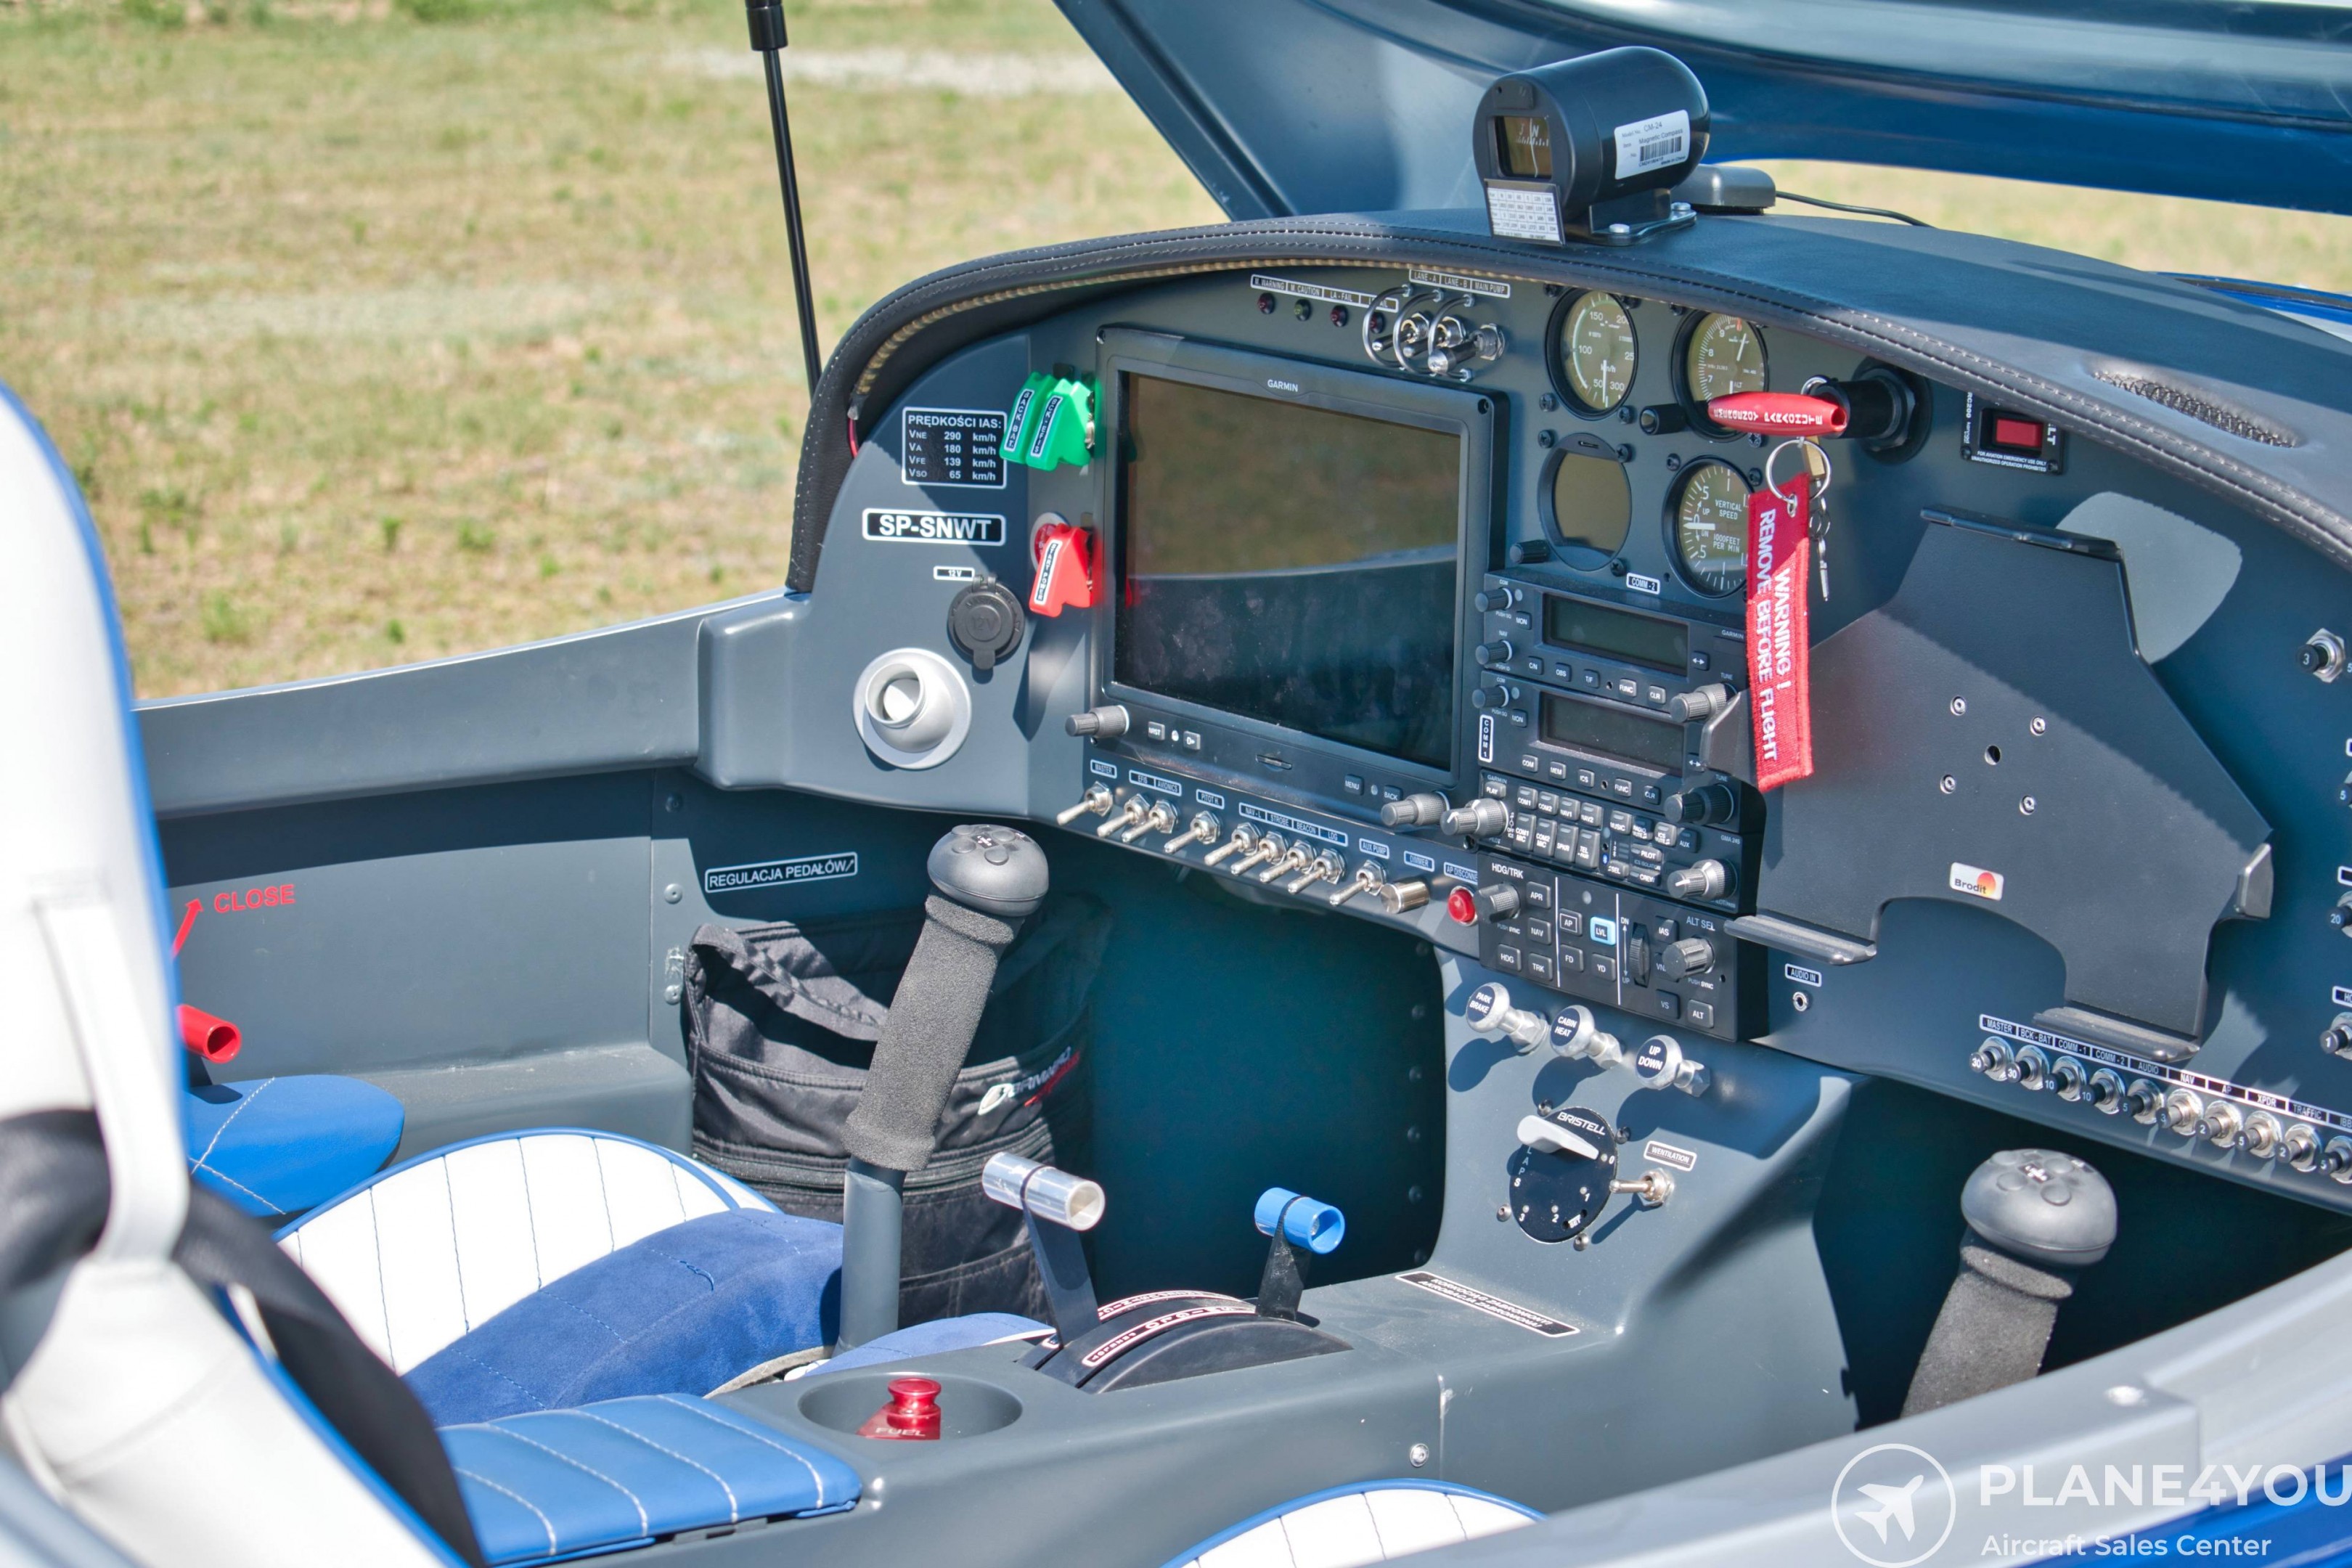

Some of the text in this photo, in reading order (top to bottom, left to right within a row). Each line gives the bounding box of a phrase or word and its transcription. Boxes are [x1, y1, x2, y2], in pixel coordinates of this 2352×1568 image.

[1643, 122, 1662, 132] CM-24
[1638, 128, 1683, 144] Magnetic Compass
[1414, 271, 1428, 281] LANE
[1261, 279, 1285, 290] WARNING
[1445, 277, 1458, 287] LANE
[1297, 285, 1320, 296] CAUTION
[1475, 282, 1505, 294] MAIN PUMP
[1342, 293, 1352, 302] FAIL
[1589, 311, 1603, 320] 150
[1579, 345, 1592, 354] 100
[1267, 379, 1298, 392] GARMIN
[1609, 381, 1625, 391] 300
[1016, 391, 1030, 420] BACK
[908, 415, 1002, 428] PRĘDKOŚCI IAS:
[1714, 408, 1823, 425] EMERGENCY PARACHUTE
[944, 431, 961, 440] 290
[973, 433, 996, 442] km/h
[1034, 426, 1047, 452] EFIS
[944, 444, 996, 455] 180 km/h
[944, 457, 996, 468] 139 km/h
[1971, 455, 2000, 465] UNAUTHORIZED
[2023, 463, 2046, 473] PROHIBITED
[950, 470, 996, 481] 65 km/h
[1715, 499, 1742, 512] VERTICAL
[1719, 510, 1738, 520] SPEED
[879, 514, 992, 539] SP-SNWT
[1037, 544, 1057, 601] START POWER
[1631, 576, 1648, 589] COMM
[1773, 568, 1792, 679] WARNING
[1722, 629, 1744, 639] GARMIN
[1755, 509, 1776, 761] REMOVE BEFORE FLIGHT
[1556, 669, 1567, 677] OBS
[1619, 684, 1633, 694] FUNC
[1649, 691, 1660, 700] CLR
[1512, 714, 1524, 723] MON
[1095, 764, 1112, 775] MASTER
[1550, 766, 1562, 775] MEM
[1138, 774, 1148, 784] EFIS
[1487, 775, 1507, 784] GARMIN
[1580, 774, 1588, 784] ICS
[1715, 774, 1728, 783] TUNE
[1158, 781, 1177, 793] AVIONICS
[1345, 779, 1360, 791] MENU
[1614, 783, 1629, 794] FUNC
[1201, 793, 1213, 803] PITOT
[1384, 791, 1398, 801] BACK
[1645, 791, 1655, 799] CLR
[1518, 797, 1531, 806] COM1
[1245, 807, 1254, 816] NAV
[1538, 804, 1552, 812] COM2
[1560, 809, 1572, 817] NAV1
[1270, 814, 1289, 827] STROBE
[1297, 822, 1316, 835] BEACON
[1516, 828, 1530, 836] COM1
[1609, 822, 1625, 832] MUSIC
[1328, 831, 1338, 841] LDG
[1536, 833, 1550, 842] COM2
[1363, 842, 1387, 855] AUX PUMP
[1556, 843, 1569, 852] SPKR
[1580, 845, 1588, 854] TEL
[1680, 840, 1690, 849] AUX
[1641, 850, 1656, 859] PILOT
[1409, 854, 1429, 867] DIMMER
[709, 859, 846, 888] REGULACJA PEDAŁÓW
[1492, 862, 1524, 879] HDG/TRK
[1954, 878, 1987, 894] Brodit
[213, 883, 296, 914] CLOSE
[1530, 891, 1543, 902] APR
[1564, 918, 1573, 928] AP
[1620, 916, 1629, 925] DN
[1686, 916, 1715, 931] ALT SEL
[2331, 913, 2341, 924] 20
[1508, 926, 1521, 935] SYNC
[1531, 926, 1544, 938] NAV
[1596, 927, 1606, 938] LVL
[1658, 926, 1670, 937] IAS
[1500, 952, 1514, 964] HDG
[1565, 955, 1574, 964] FD
[1532, 963, 1545, 973] TRK
[1597, 964, 1606, 973] YD
[1791, 968, 1808, 981] AUDIO
[1701, 980, 1714, 989] SYNC
[1477, 992, 1492, 1004] PARK
[1470, 1000, 1489, 1013] BRAKE
[1660, 1000, 1670, 1010] VS
[1692, 1009, 1704, 1020] ALT
[1558, 1016, 1577, 1028] CABIN
[1987, 1019, 2012, 1034] MASTER
[1555, 1026, 1572, 1037] HEAT
[2020, 1028, 2051, 1045] BCK BAT
[1649, 1045, 1661, 1055] UP
[2058, 1039, 2078, 1053] COMM
[2096, 1050, 2115, 1063] COMM
[1638, 1056, 1663, 1071] DOWN
[1972, 1058, 1981, 1069] 30
[2138, 1062, 2159, 1074] AUDIO
[2008, 1067, 2017, 1079] 30
[2044, 1079, 2054, 1090] 10
[2180, 1073, 2195, 1086] NAV
[2221, 1084, 2232, 1094] AP
[2082, 1090, 2091, 1102] 10
[2257, 1094, 2277, 1107] XPDR
[2293, 1103, 2322, 1121] TRAFFIC
[1557, 1112, 1606, 1136] BRISTELL
[1651, 1146, 1690, 1164] WENTILATION
[1569, 1214, 1581, 1228] SET
[875, 1427, 926, 1437] FUEL
